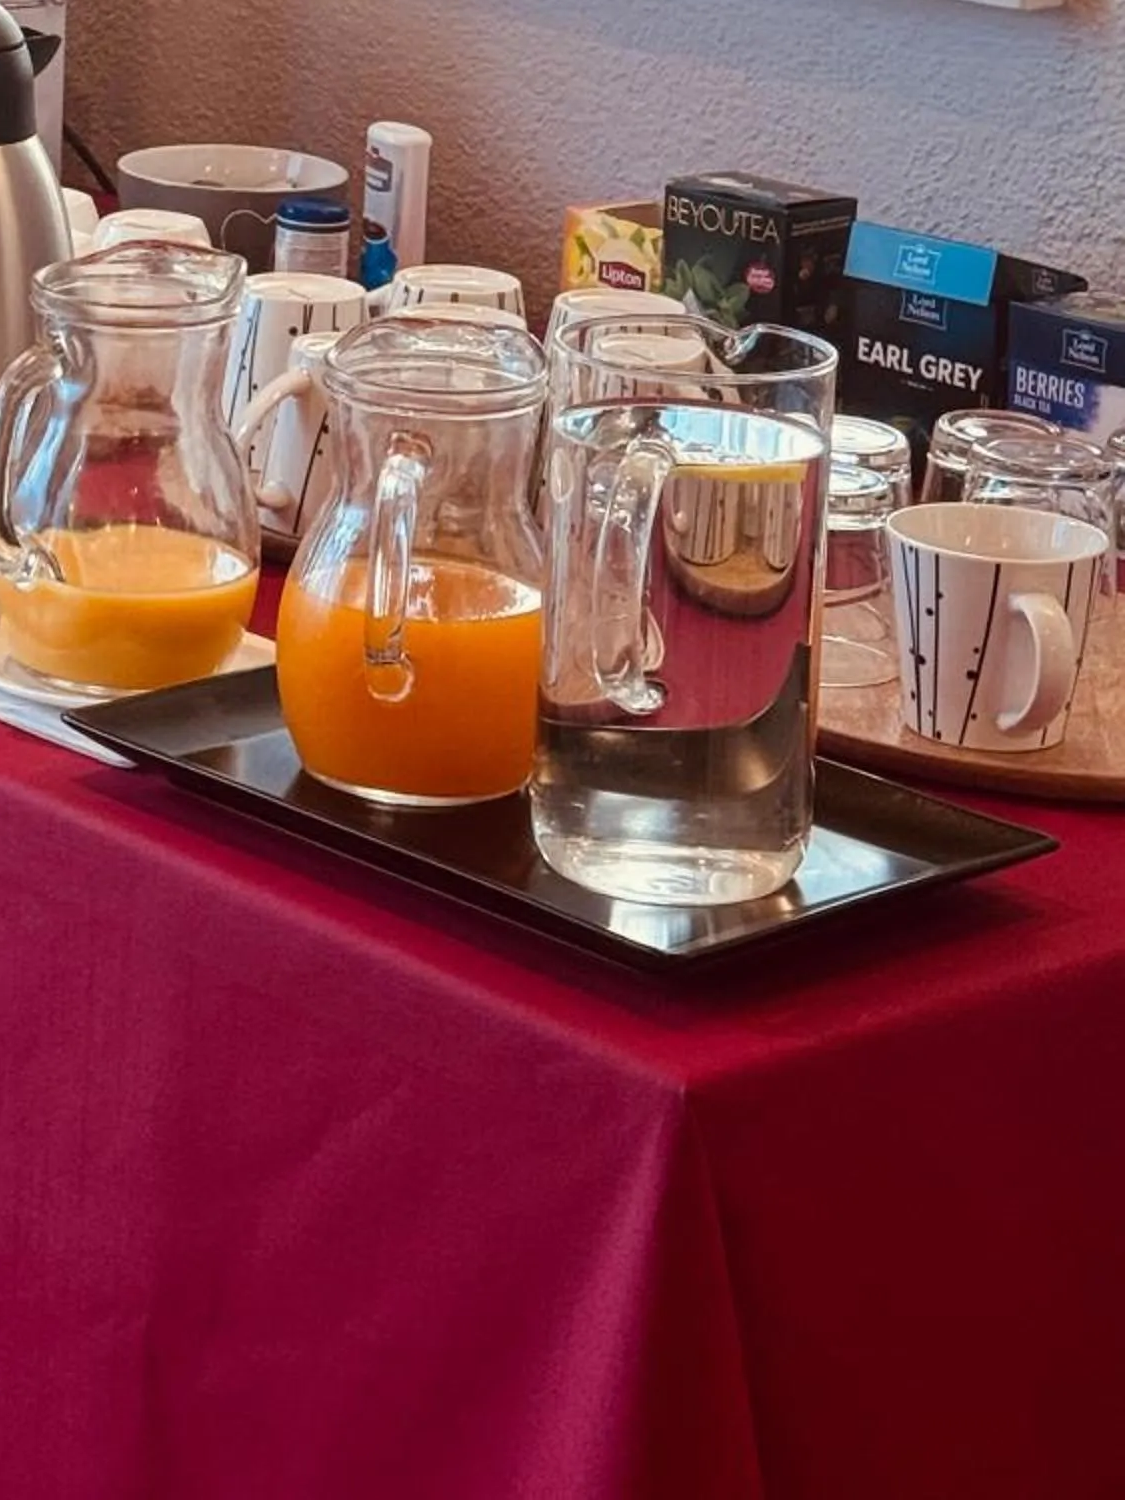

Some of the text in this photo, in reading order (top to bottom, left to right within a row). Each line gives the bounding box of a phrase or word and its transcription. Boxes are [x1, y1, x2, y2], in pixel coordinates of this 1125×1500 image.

[602, 263, 643, 288] Lipton
[857, 335, 984, 392] EARL GREY
[1016, 365, 1086, 409] BERRIES
